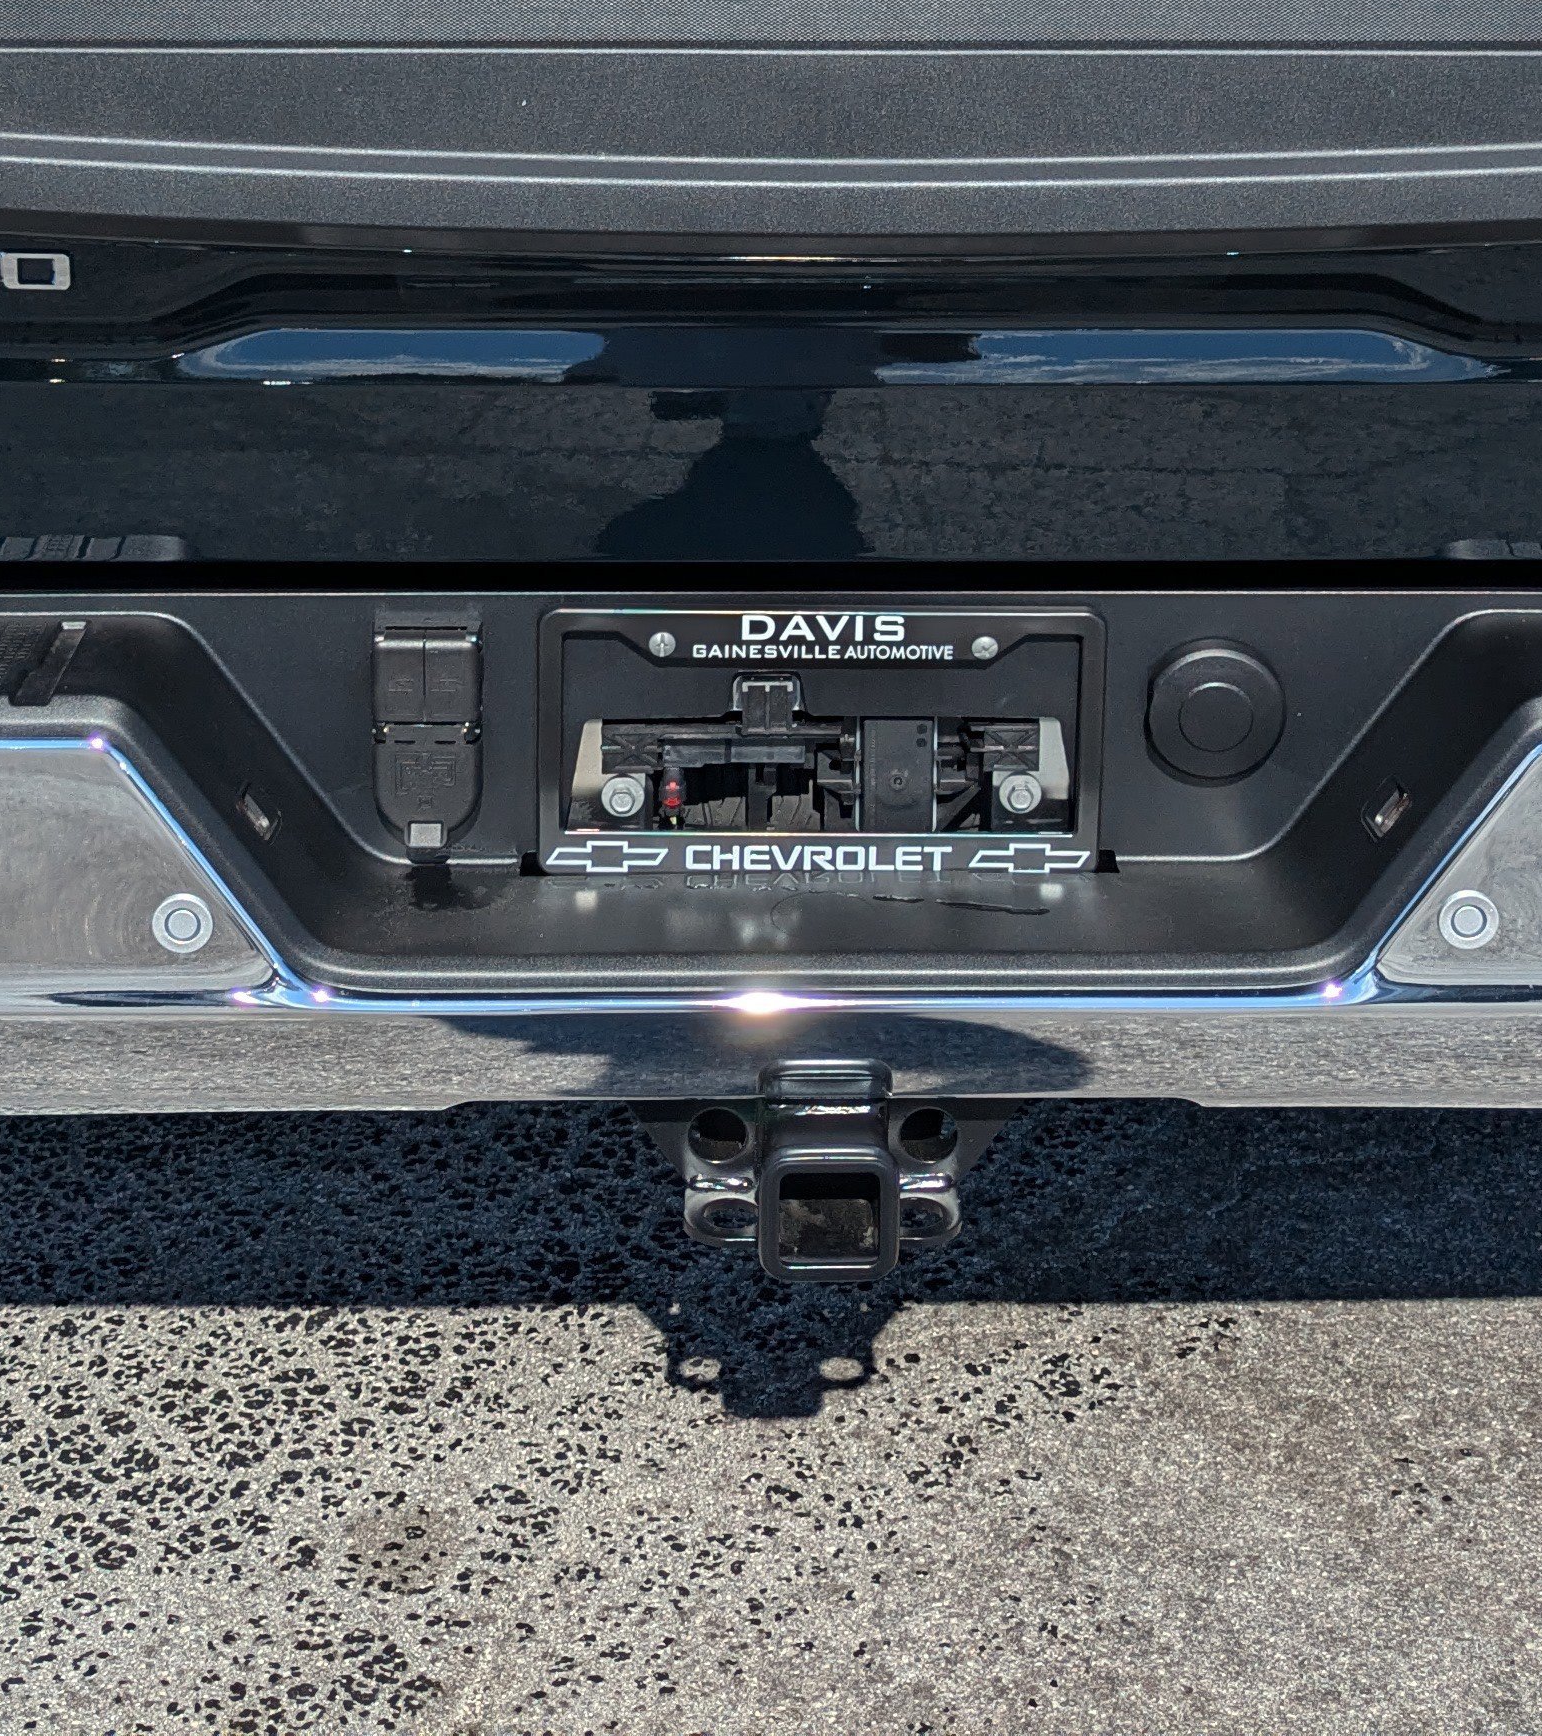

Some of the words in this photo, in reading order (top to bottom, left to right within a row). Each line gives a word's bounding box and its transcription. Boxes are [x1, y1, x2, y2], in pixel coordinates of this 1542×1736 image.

[740, 614, 906, 642] DAVIS
[692, 644, 841, 660] GAINESVILLE
[844, 644, 954, 661] AUTOMOTIVE
[685, 844, 953, 872] CHEVROLET
